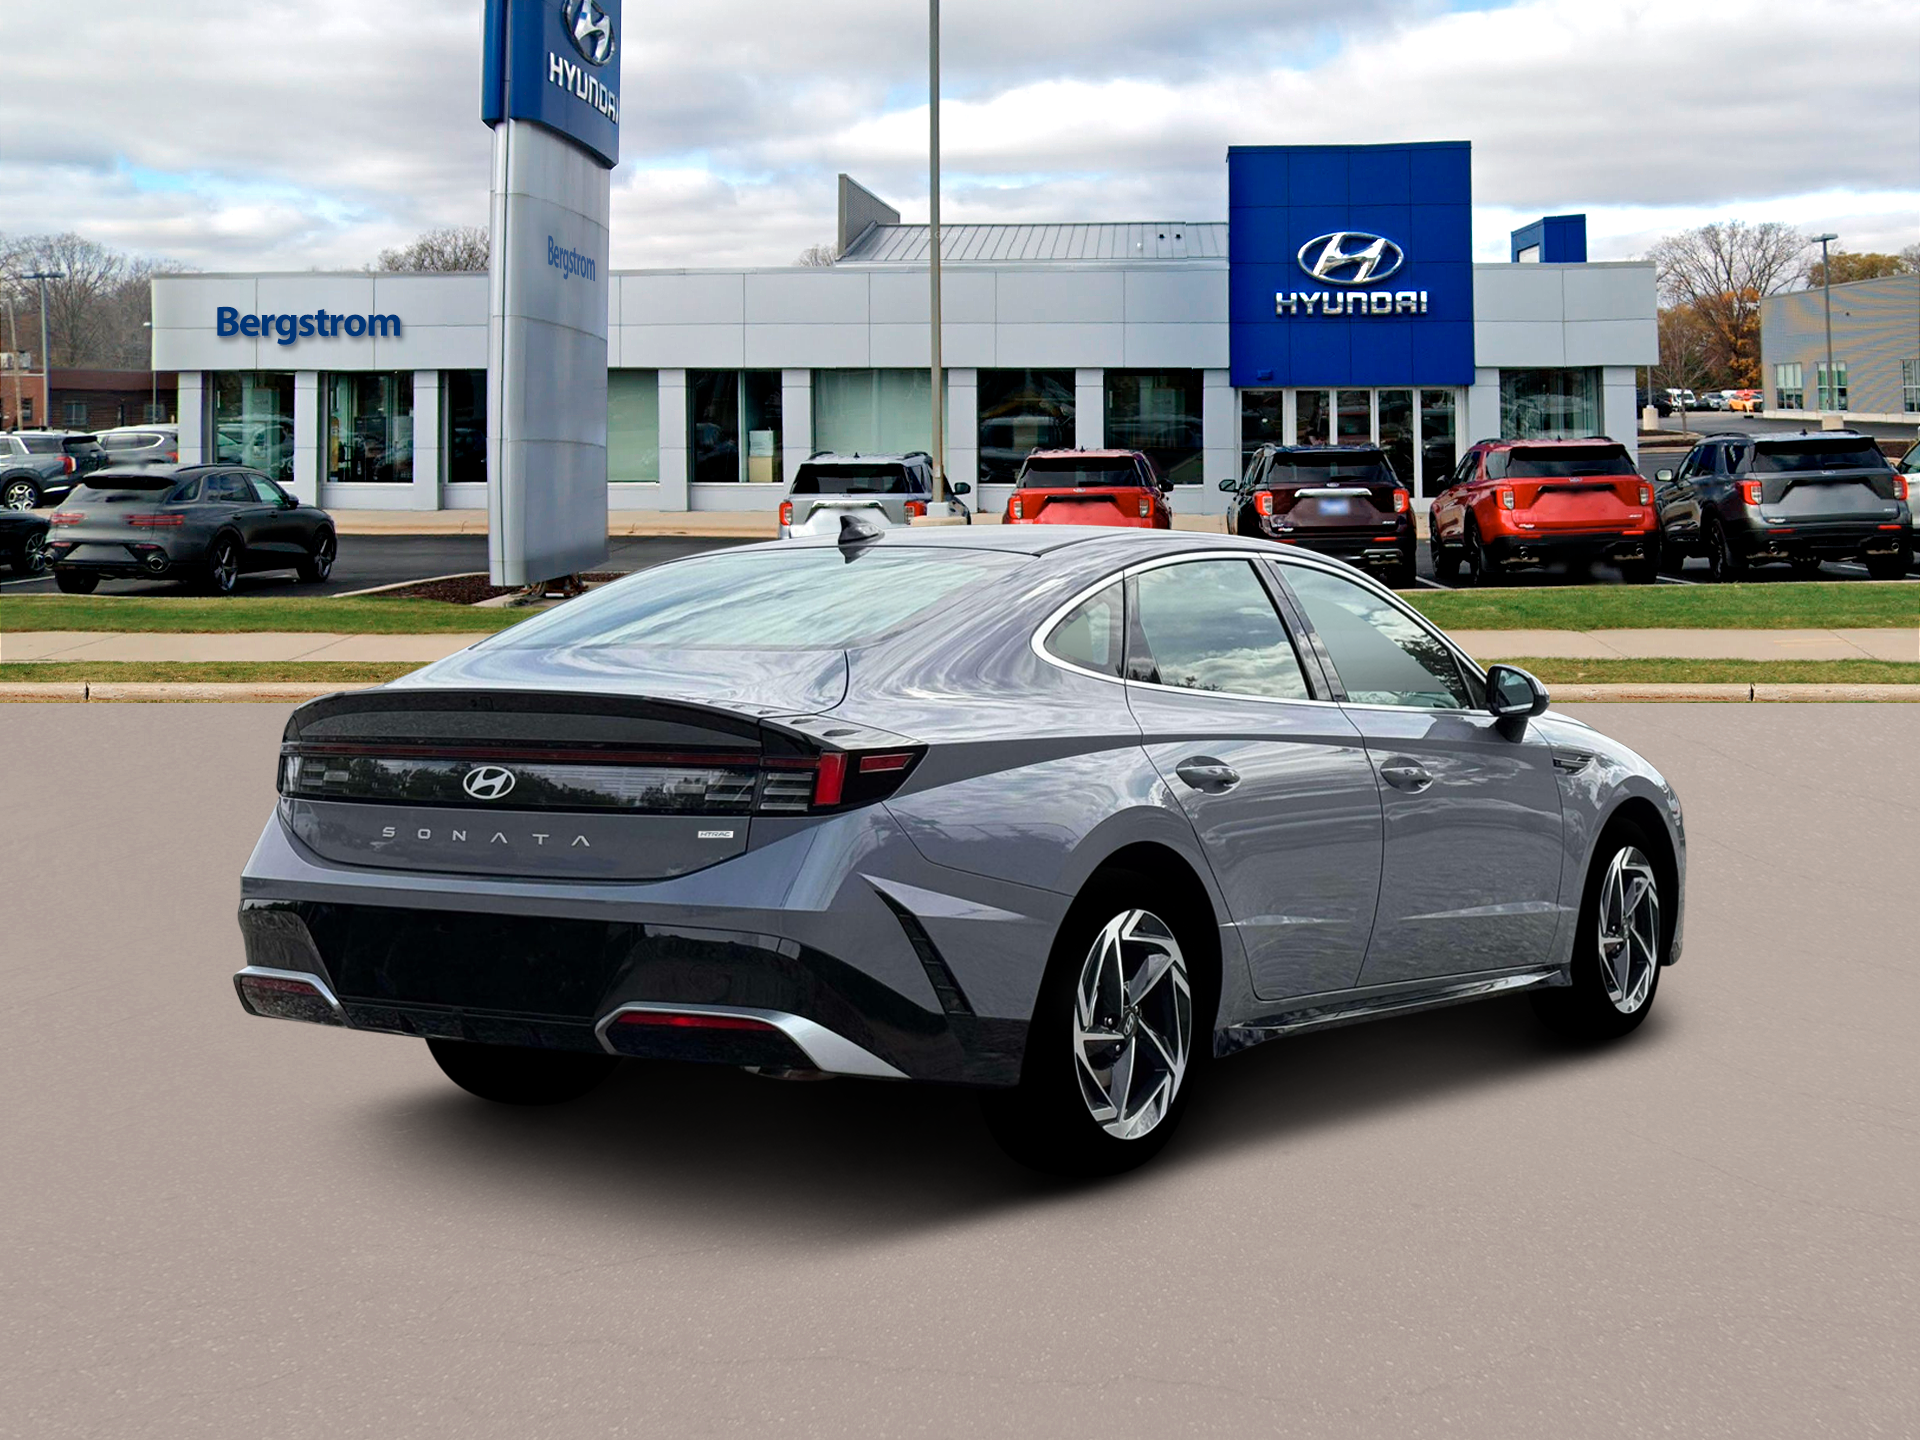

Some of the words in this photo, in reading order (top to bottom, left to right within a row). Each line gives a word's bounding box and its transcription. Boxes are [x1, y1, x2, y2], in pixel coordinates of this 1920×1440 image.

[549, 52, 618, 124] HYUNDAI
[548, 235, 595, 282] Bergstrom
[1275, 291, 1428, 315] HYUNDAI
[217, 306, 401, 346] Bergstrom
[382, 826, 590, 847] SONATA
